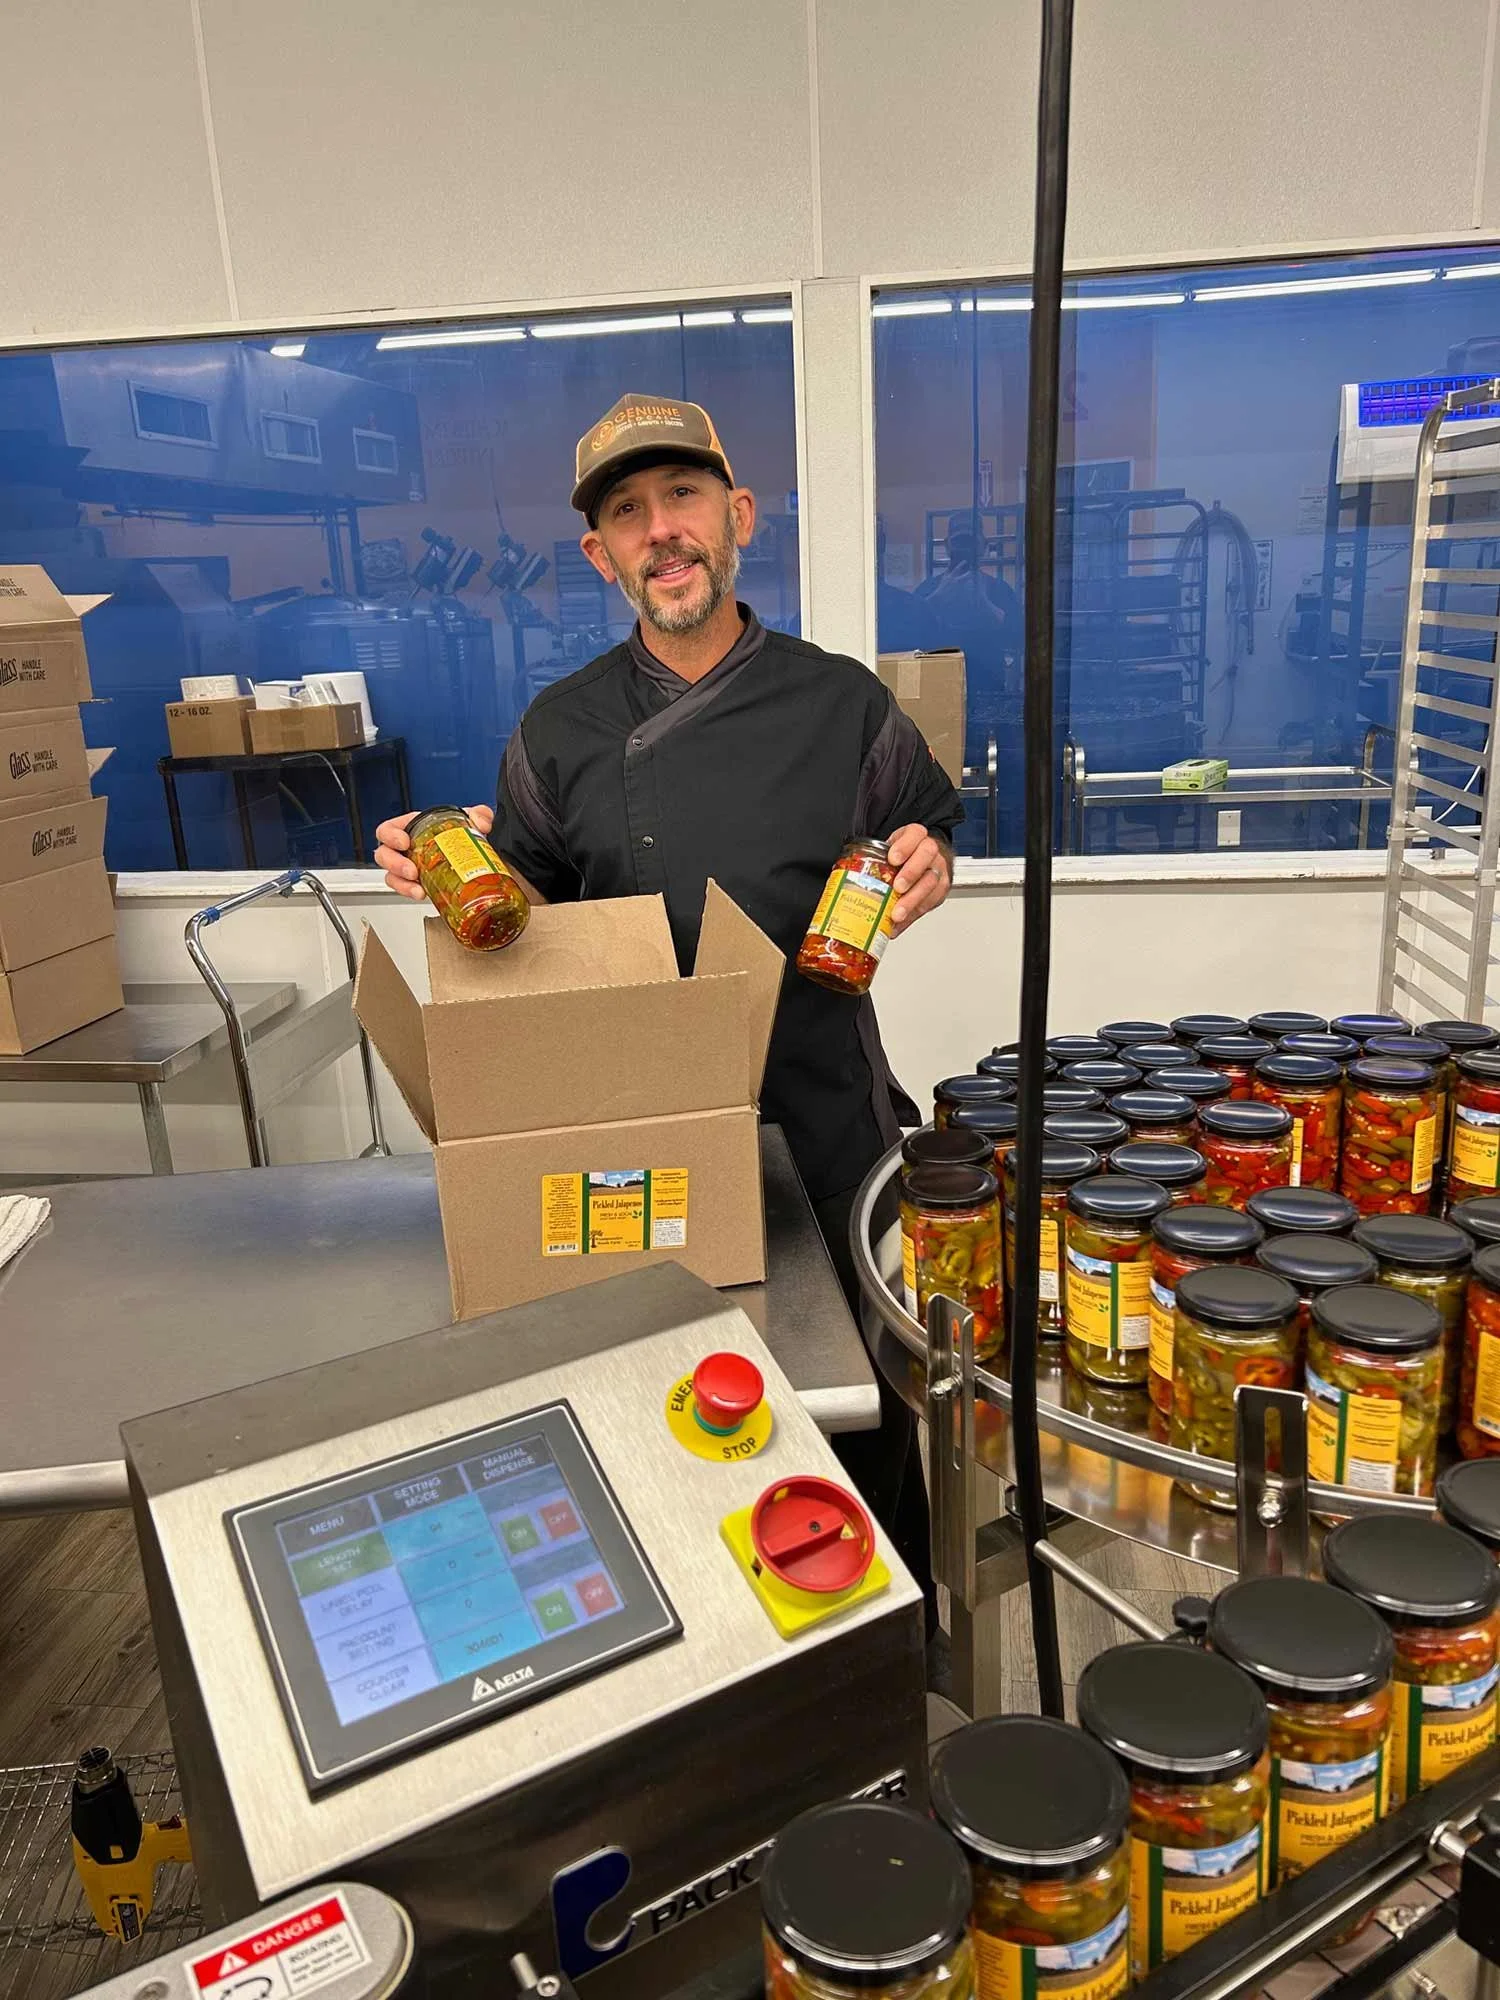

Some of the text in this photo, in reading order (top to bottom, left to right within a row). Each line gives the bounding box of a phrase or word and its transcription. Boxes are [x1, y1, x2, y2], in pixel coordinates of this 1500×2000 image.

[615, 406, 680, 423] GENUINE
[22, 659, 42, 670] HANDLE
[19, 670, 46, 681] WITH CARE
[169, 708, 179, 717] 12
[187, 707, 198, 716] 16
[34, 749, 54, 762] HANDLE
[9, 751, 31, 780] Glass
[32, 760, 58, 773] WITH CARE
[56, 825, 75, 838] HANDLE
[32, 828, 53, 857] Glass
[52, 835, 78, 850] WITH CARE
[723, 1437, 757, 1459] STOP
[483, 1447, 528, 1469] MANUAL
[483, 1457, 536, 1480] DISPENSE
[394, 1476, 441, 1500] SETTING
[404, 1489, 440, 1508] MODE
[309, 1515, 345, 1536] MENU
[548, 1512, 568, 1525] OFF
[511, 1527, 528, 1540] ON
[584, 1586, 605, 1600] OFF
[545, 1604, 563, 1617] ON
[494, 1665, 535, 1691] DELTA
[1428, 1729, 1465, 1747] Pickled
[1287, 1809, 1327, 1827] Pickled
[651, 1852, 756, 1935] PACK
[1170, 1898, 1212, 1915] Pickled
[251, 1912, 324, 1956] DANGER
